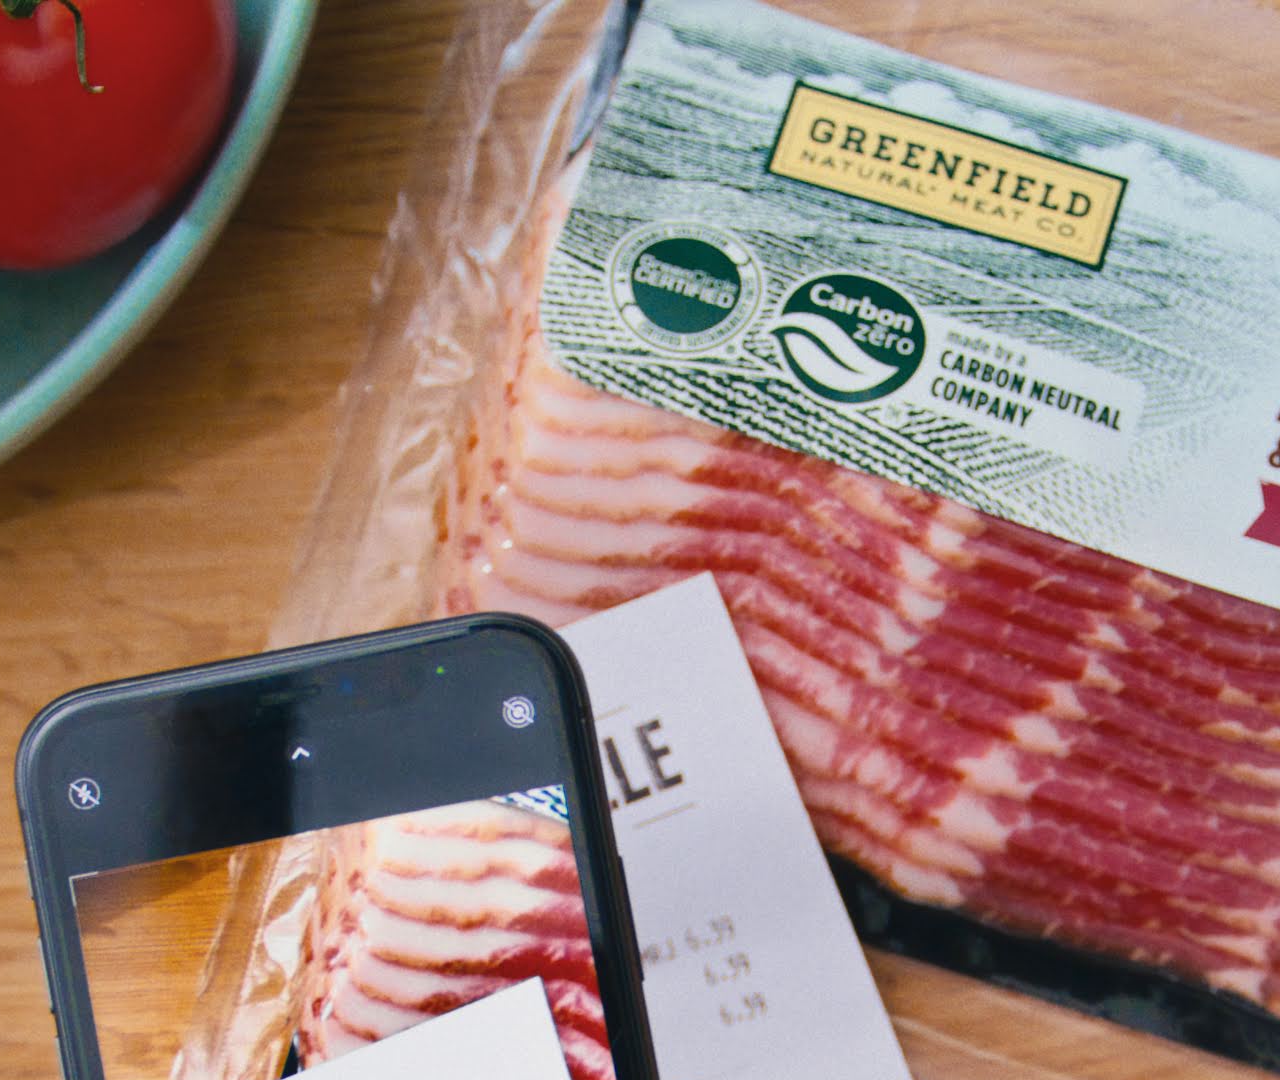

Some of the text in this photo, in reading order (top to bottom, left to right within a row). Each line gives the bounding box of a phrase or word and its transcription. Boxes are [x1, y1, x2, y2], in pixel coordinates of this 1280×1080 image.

[808, 117, 1093, 218] GREENFIELD
[950, 191, 1024, 223] MEAT
[1035, 216, 1084, 243] CO.
[809, 282, 915, 334] Carbon
[946, 330, 991, 352] made
[994, 342, 1015, 365] by
[930, 376, 1034, 428] COMPANY
[939, 349, 1121, 431] CARBON NEUTRAL
